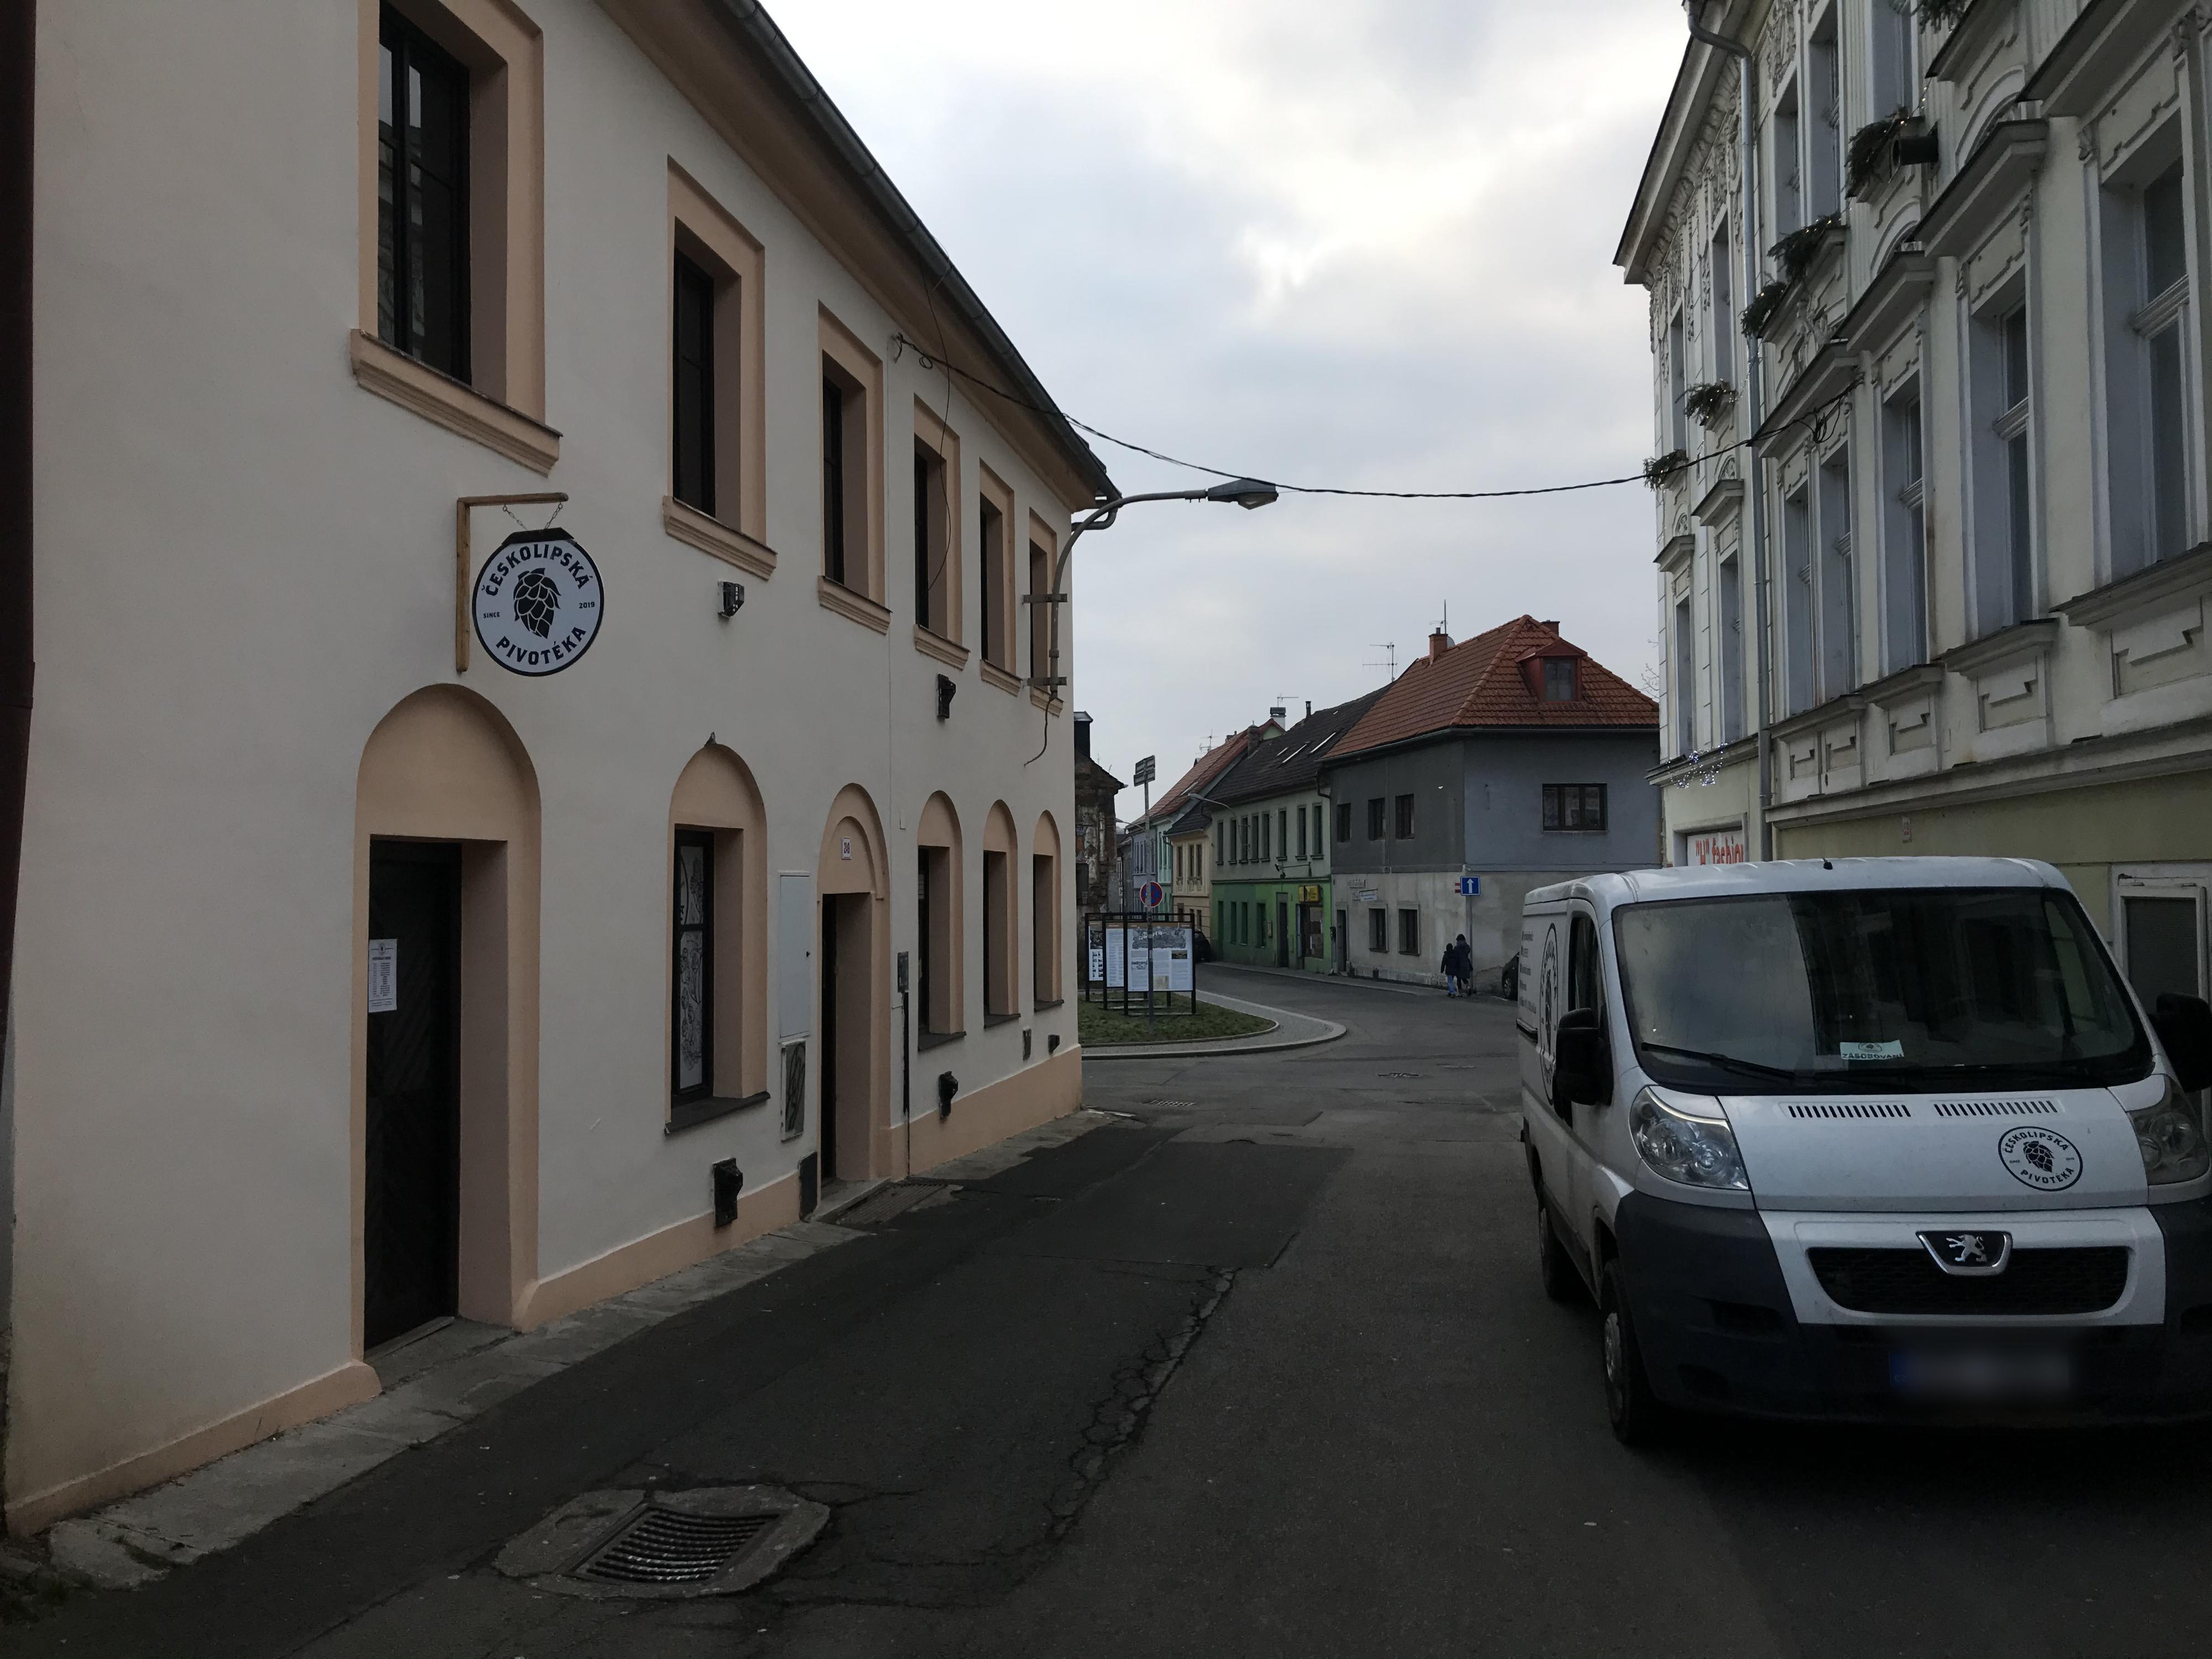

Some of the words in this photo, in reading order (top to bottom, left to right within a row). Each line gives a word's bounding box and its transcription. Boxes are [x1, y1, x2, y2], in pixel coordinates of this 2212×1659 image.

[481, 544, 593, 596] ČESKOLIPSKÁ
[495, 626, 587, 665] PIVOTÉKA
[1712, 834, 1744, 864] fashio
[2002, 1131, 2070, 1154] ČESKOLIPSKÁ
[2021, 1167, 2074, 1183] PIVOTÉKA
